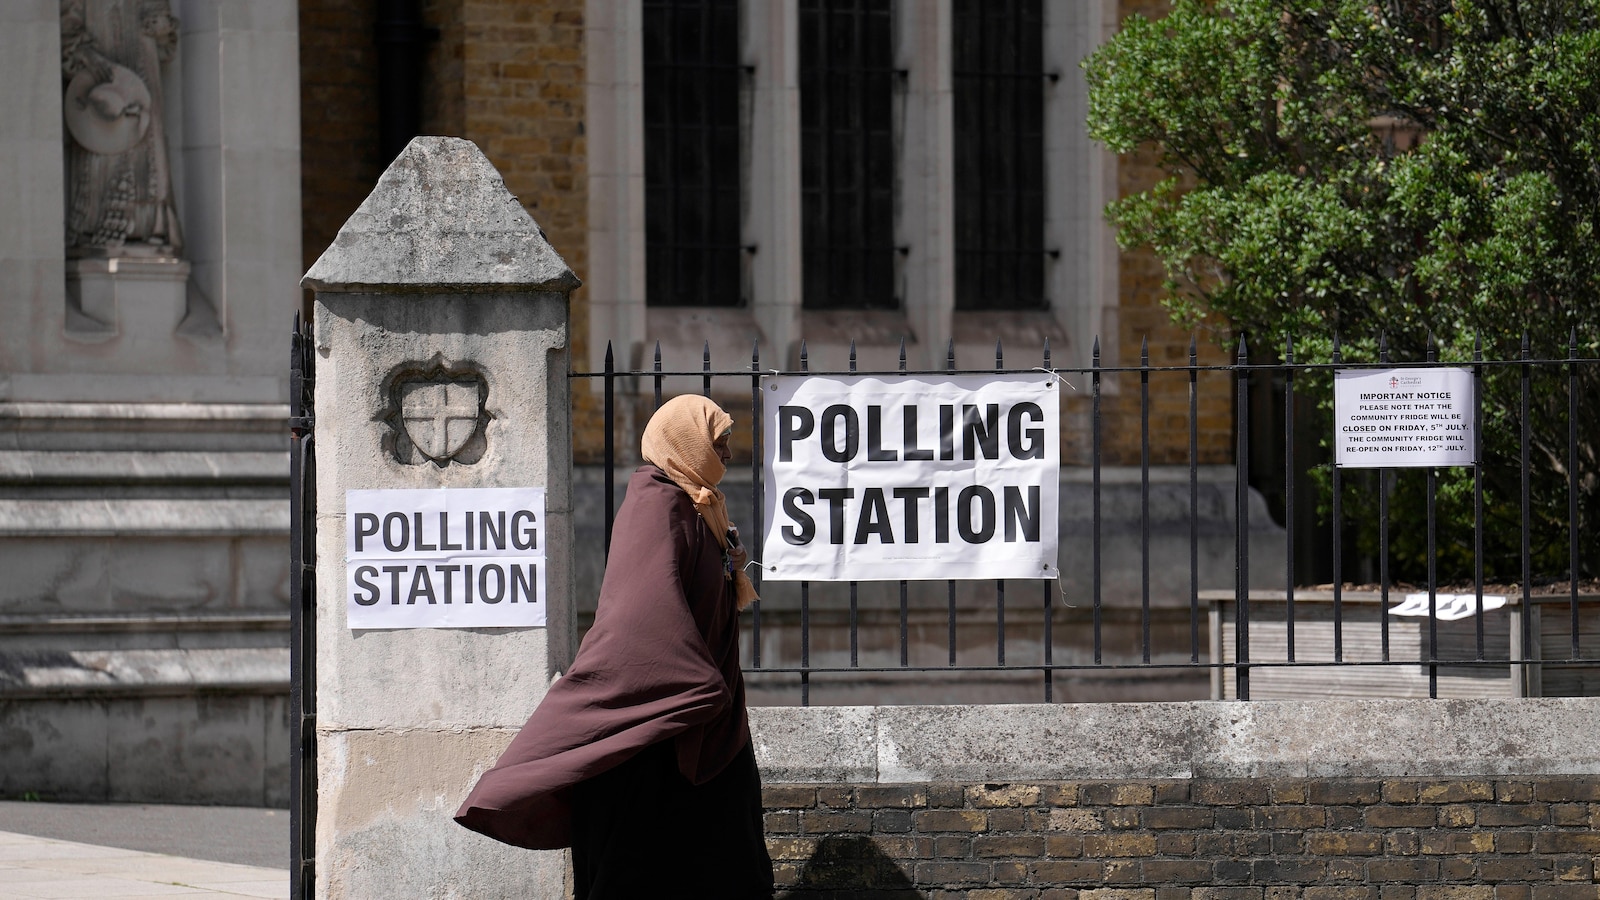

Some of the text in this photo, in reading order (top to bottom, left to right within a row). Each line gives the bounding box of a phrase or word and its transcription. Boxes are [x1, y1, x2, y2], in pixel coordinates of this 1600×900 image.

[779, 402, 1044, 463] POLLING
[354, 510, 537, 552] POLLING
[781, 485, 1040, 546] STATION
[354, 564, 537, 606] STATION
